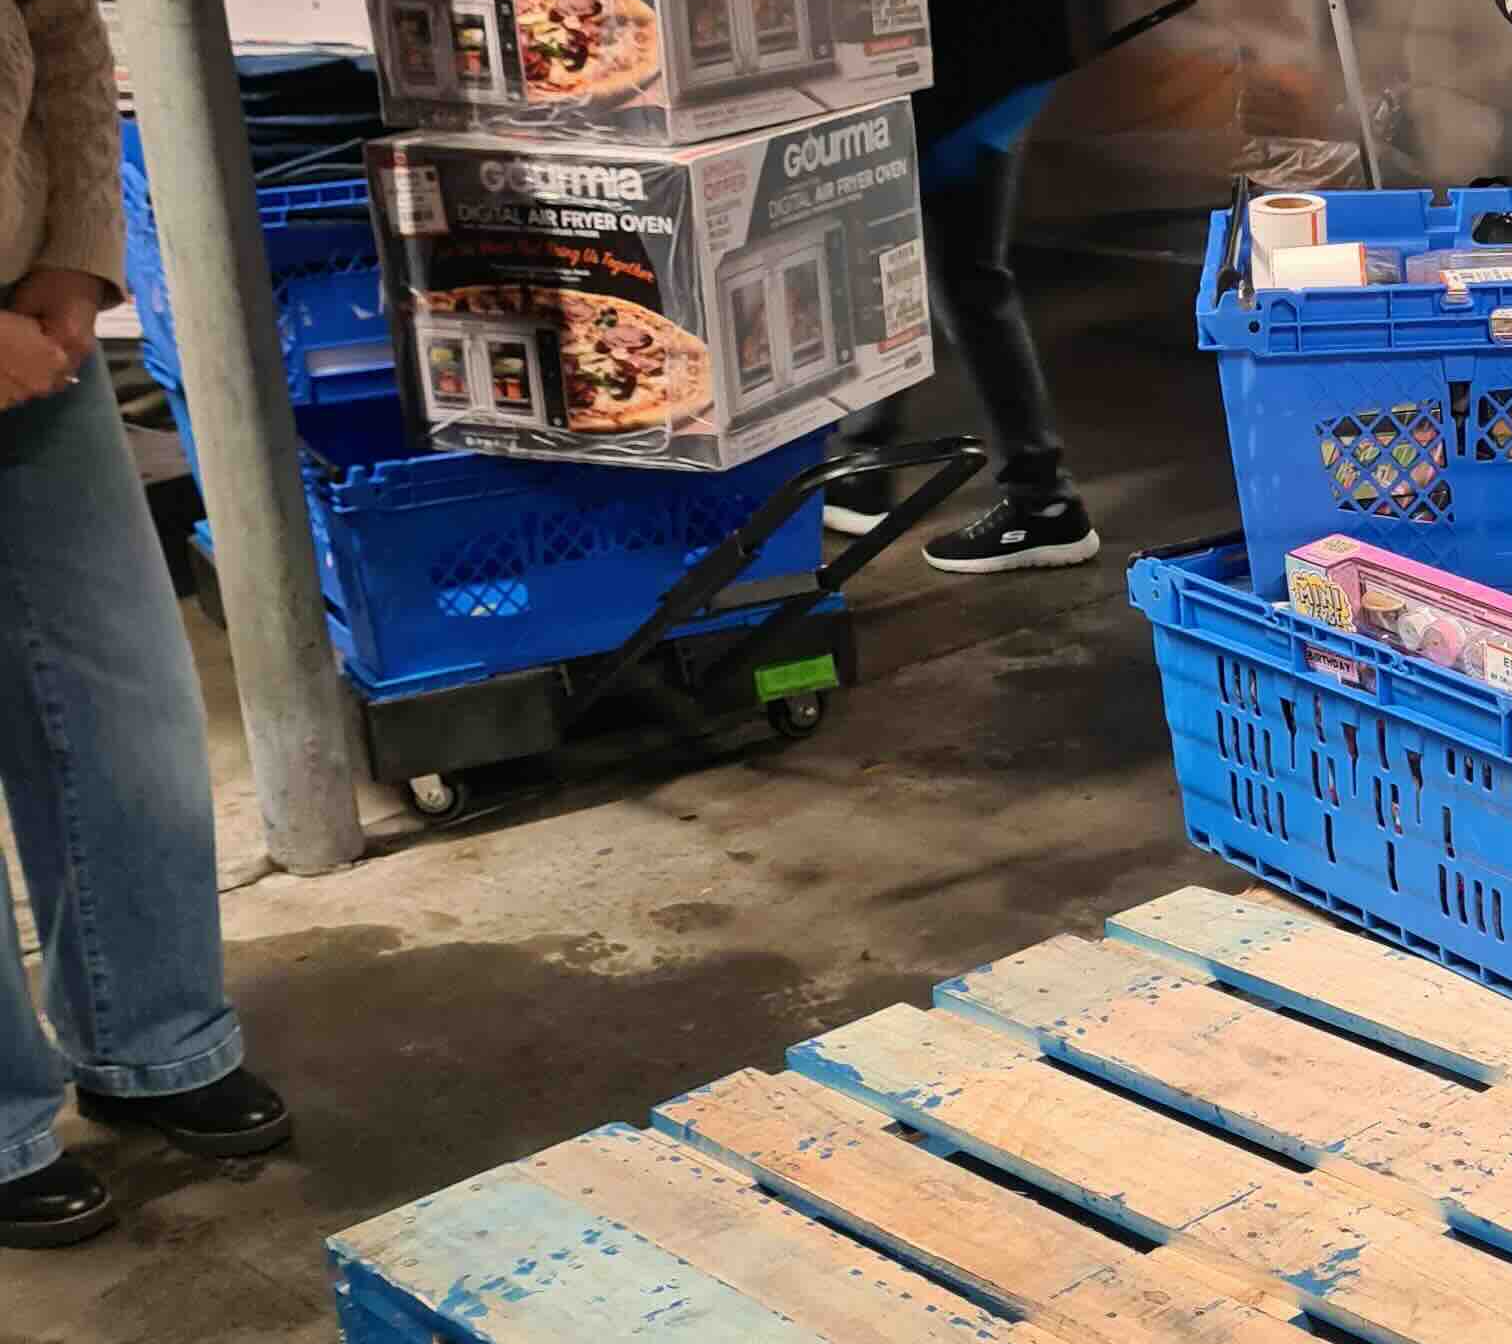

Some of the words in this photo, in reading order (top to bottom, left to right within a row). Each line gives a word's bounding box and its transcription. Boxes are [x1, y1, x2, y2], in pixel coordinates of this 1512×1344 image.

[528, 208, 557, 226] AIR
[561, 209, 618, 233] FRYER
[621, 213, 673, 235] OVEN
